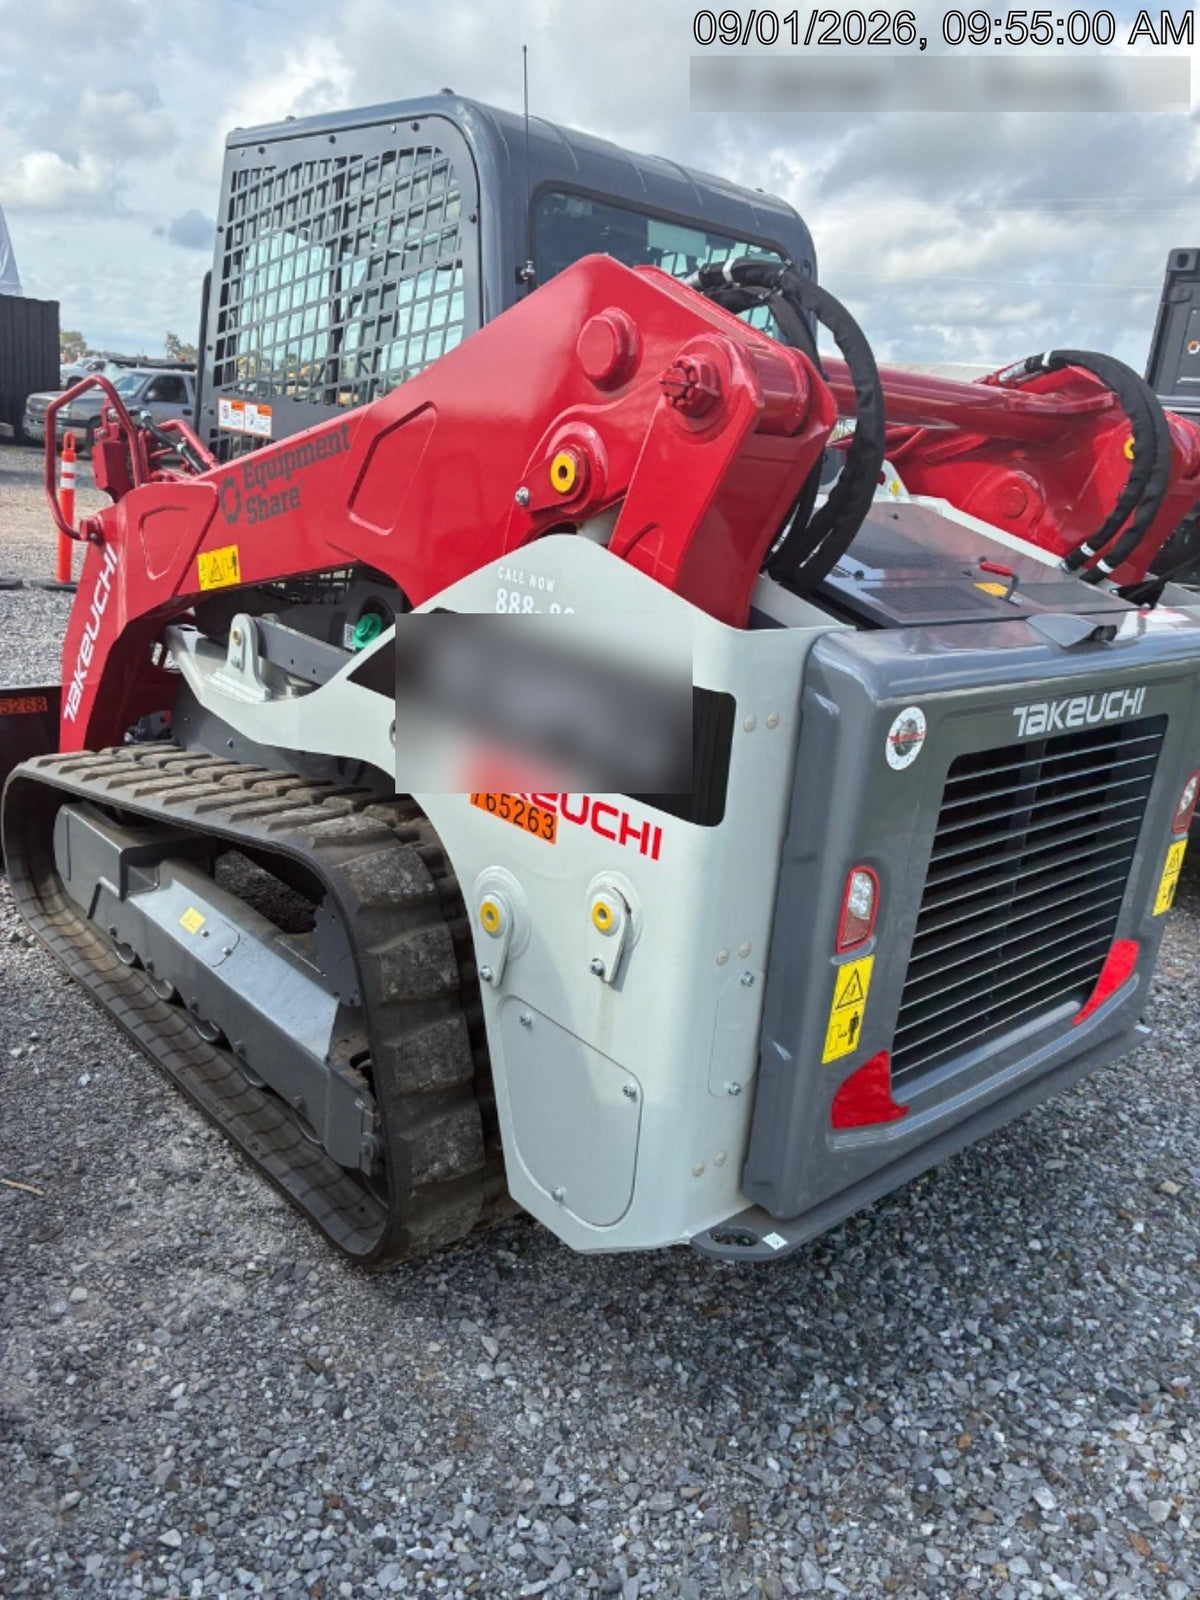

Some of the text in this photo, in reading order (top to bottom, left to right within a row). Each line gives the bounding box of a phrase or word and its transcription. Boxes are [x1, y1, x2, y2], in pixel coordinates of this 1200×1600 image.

[242, 422, 350, 490] Equipment
[245, 486, 302, 525] Share
[498, 566, 556, 593] CALL NOW
[1012, 686, 1147, 737] TAKEUCHI
